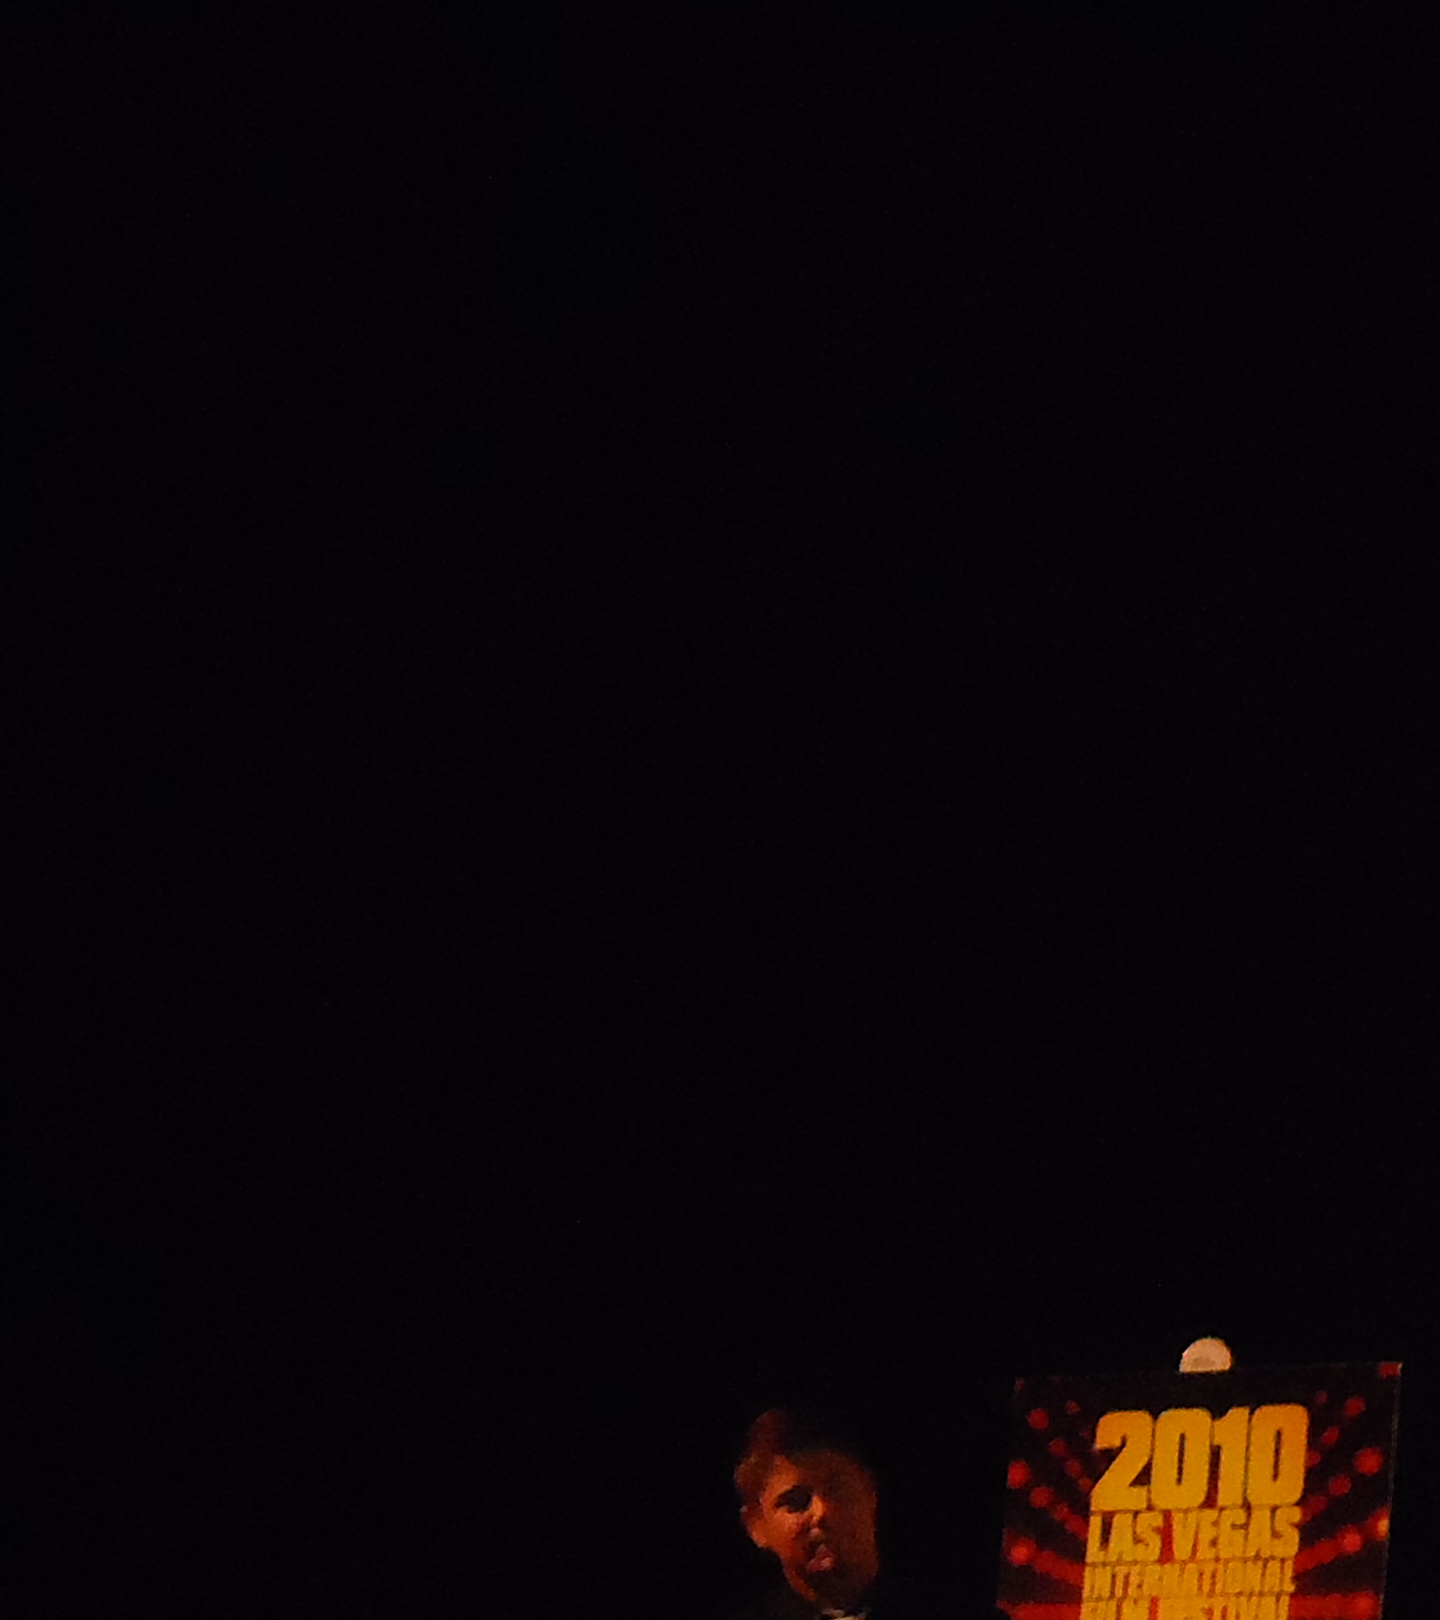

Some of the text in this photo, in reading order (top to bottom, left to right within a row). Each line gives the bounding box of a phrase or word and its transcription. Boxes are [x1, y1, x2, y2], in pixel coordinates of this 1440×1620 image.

[1090, 1404, 1309, 1511] 2010
[1085, 1505, 1300, 1563] LAS VEGAS
[1083, 1559, 1296, 1600] INTERNATIONAL
